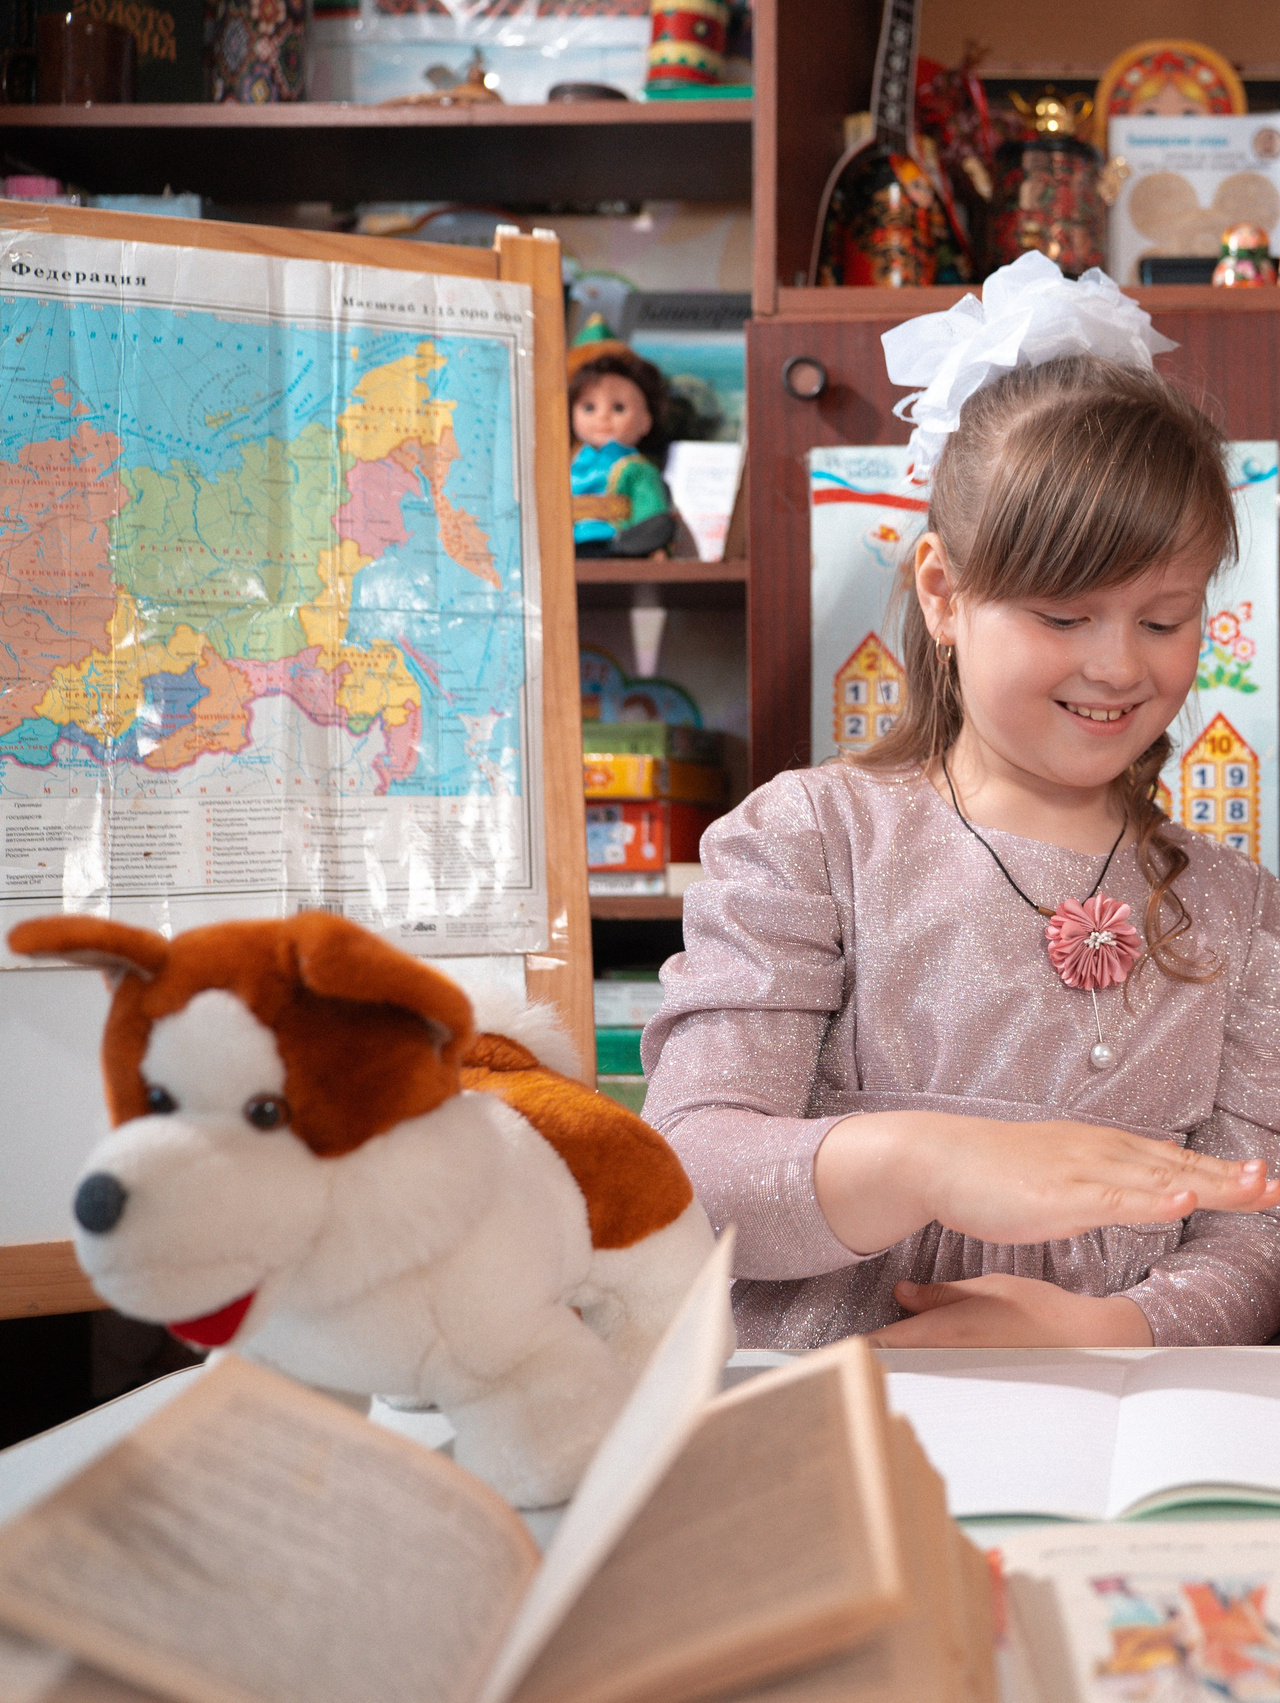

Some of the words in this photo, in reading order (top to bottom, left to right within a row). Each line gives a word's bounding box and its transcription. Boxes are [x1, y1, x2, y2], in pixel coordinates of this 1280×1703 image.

[11, 262, 147, 287] Федерация
[341, 295, 416, 314] Масштаб
[865, 652, 879, 671] 2
[850, 684, 860, 701] 1
[883, 684, 892, 700] 1
[849, 716, 862, 735] 2
[1206, 735, 1231, 755] 10
[1195, 768, 1206, 786] 1
[1229, 767, 1245, 786] 9
[1195, 801, 1209, 820] 2
[1229, 800, 1245, 820] 8
[1229, 836, 1244, 850] 7
